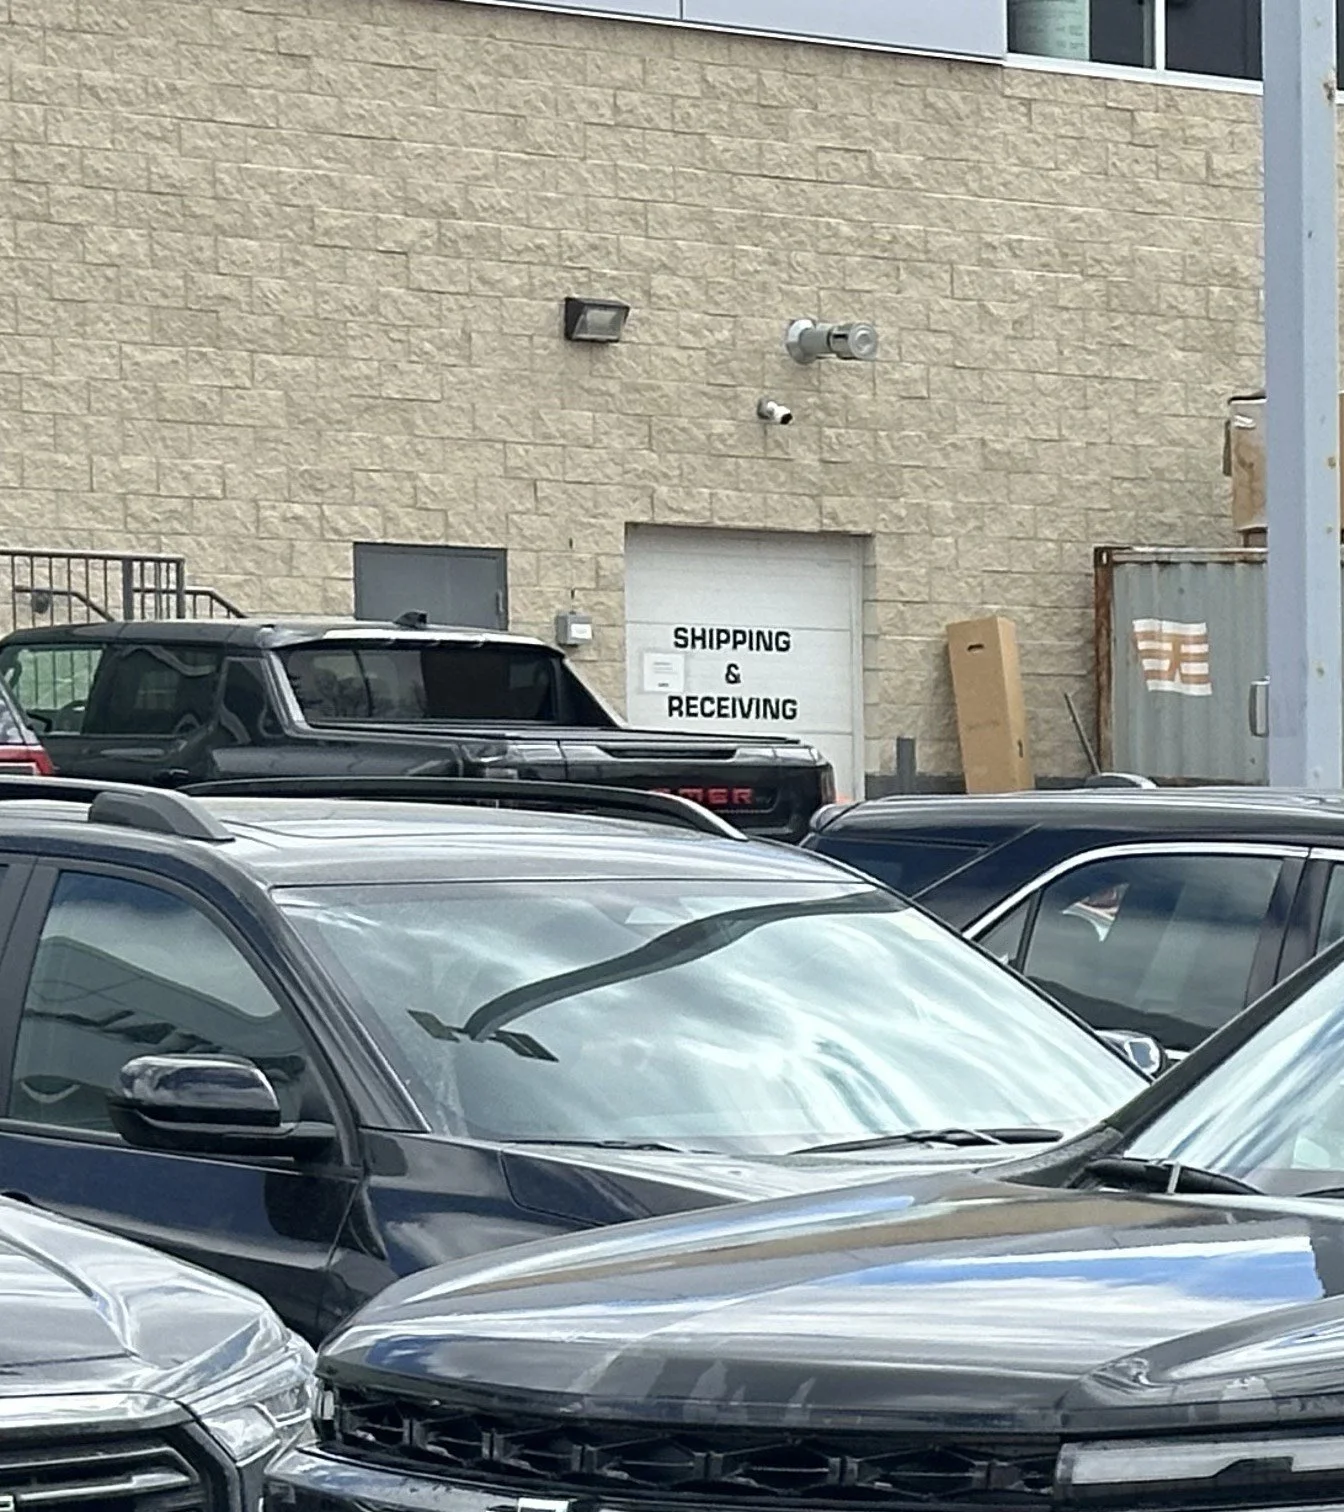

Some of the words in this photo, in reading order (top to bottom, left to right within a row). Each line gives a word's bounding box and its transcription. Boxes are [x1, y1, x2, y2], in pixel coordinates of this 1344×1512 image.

[673, 626, 792, 652] SHIPPING
[725, 663, 742, 684] &
[668, 695, 799, 720] RECEIVING
